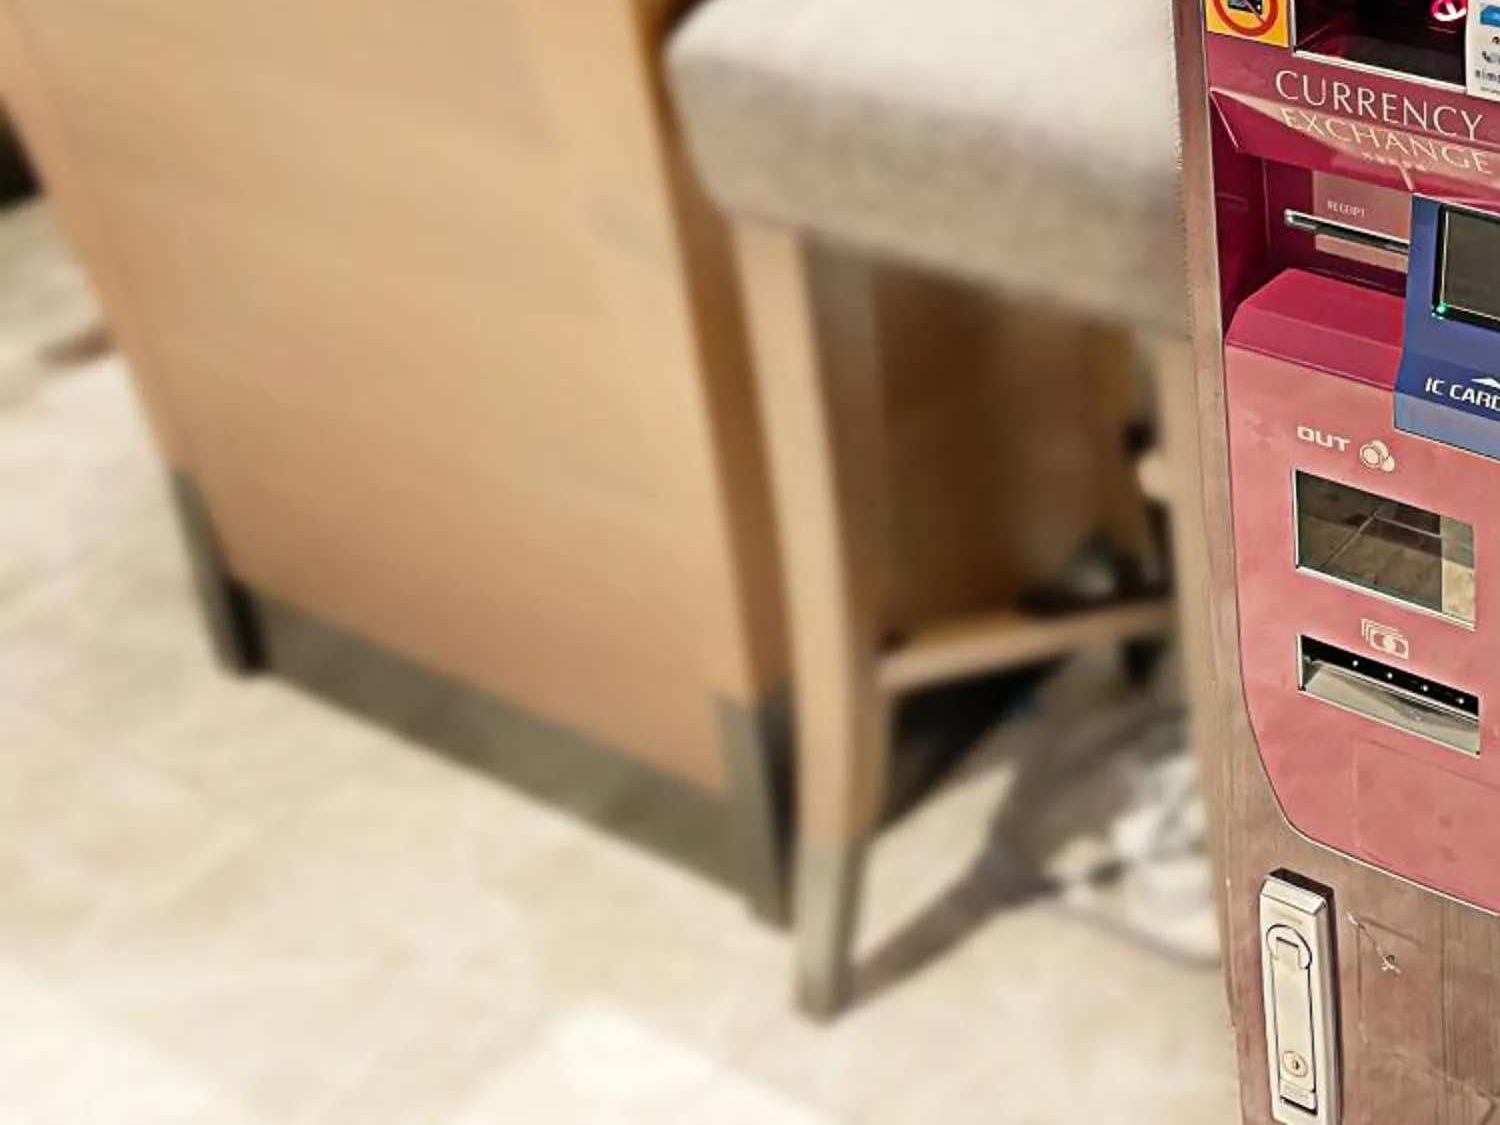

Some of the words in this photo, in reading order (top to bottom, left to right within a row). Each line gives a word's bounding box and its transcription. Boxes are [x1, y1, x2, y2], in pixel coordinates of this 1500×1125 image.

[1275, 70, 1484, 142] CURRENCY
[1279, 106, 1493, 175] EXCHANGE
[1425, 378, 1446, 396] IC
[1297, 426, 1351, 453] OUT
